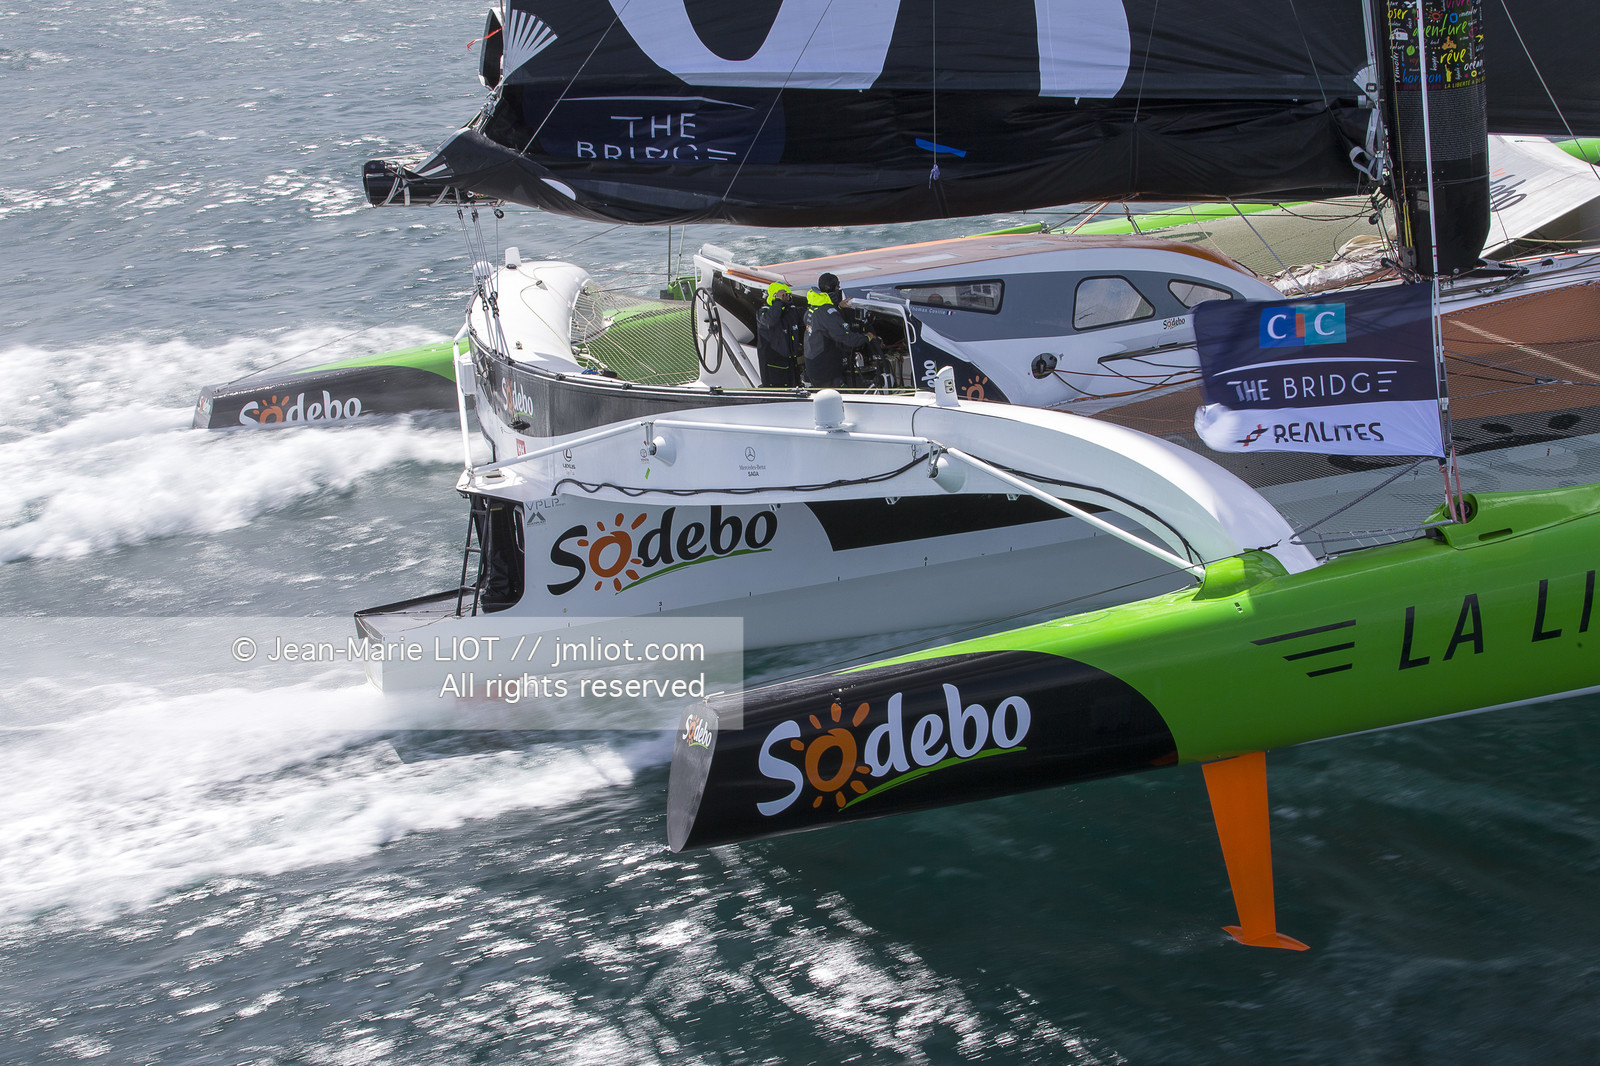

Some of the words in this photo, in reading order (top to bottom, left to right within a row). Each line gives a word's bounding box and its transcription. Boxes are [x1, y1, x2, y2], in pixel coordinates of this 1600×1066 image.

[1388, 8, 1408, 20] oser
[1412, 13, 1467, 37] aenture
[1440, 49, 1466, 64] rêve
[1402, 68, 1442, 83] horon
[611, 113, 696, 138] THE
[1267, 311, 1336, 340] CIC
[1226, 379, 1271, 401] THE
[1284, 370, 1397, 399] BRIDGE
[1274, 421, 1384, 443] REALITES
[525, 498, 560, 511] VPLP
[547, 505, 778, 596] Sodebo
[1399, 593, 1484, 671] LA
[682, 713, 712, 747] Sodebo
[756, 683, 1031, 816] Sodebo
